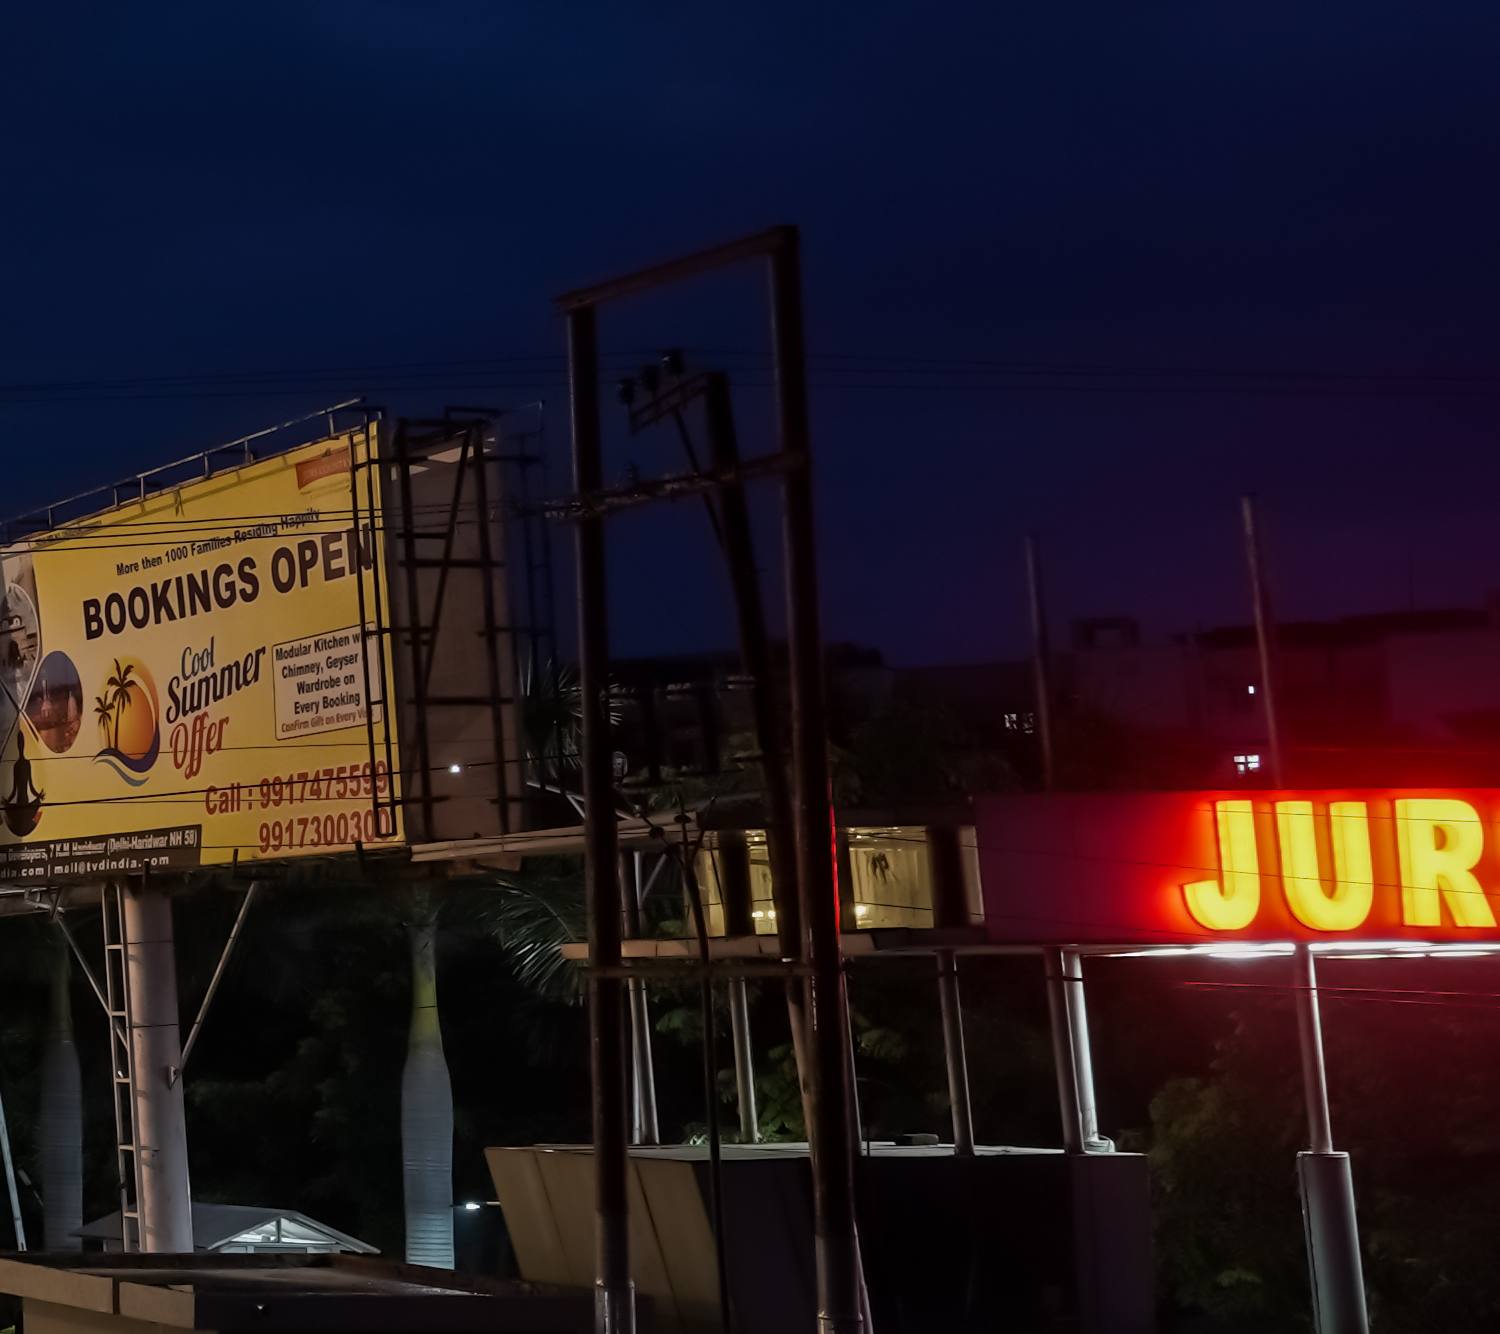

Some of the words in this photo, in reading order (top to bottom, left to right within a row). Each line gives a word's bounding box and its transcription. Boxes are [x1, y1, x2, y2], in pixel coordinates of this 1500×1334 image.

[116, 563, 139, 576] More
[141, 556, 163, 570] then
[165, 545, 188, 563] 1000
[190, 535, 232, 557] Families
[233, 521, 278, 545] Residing
[280, 507, 320, 530] Happily
[83, 556, 260, 641] BOOKINGS
[271, 522, 374, 594] OPEN
[181, 635, 215, 681] Cool
[275, 643, 312, 661] Modular
[313, 633, 350, 653] Kitchen
[281, 662, 324, 679] Chimney,
[326, 653, 359, 670] Geyser
[166, 645, 266, 724] Summer
[294, 700, 320, 715] Every
[322, 691, 361, 710] Booking
[296, 675, 341, 695] Wardrobe
[343, 673, 355, 686] on
[325, 714, 335, 724] on
[336, 711, 357, 723] Every
[169, 711, 230, 780] Offer
[205, 782, 241, 815] Call
[259, 760, 388, 809] 9917475599
[169, 831, 182, 847] NH
[259, 807, 390, 854] 9917300300
[54, 855, 170, 875] mail@tvdindia.om
[1181, 797, 1499, 932] JUR
